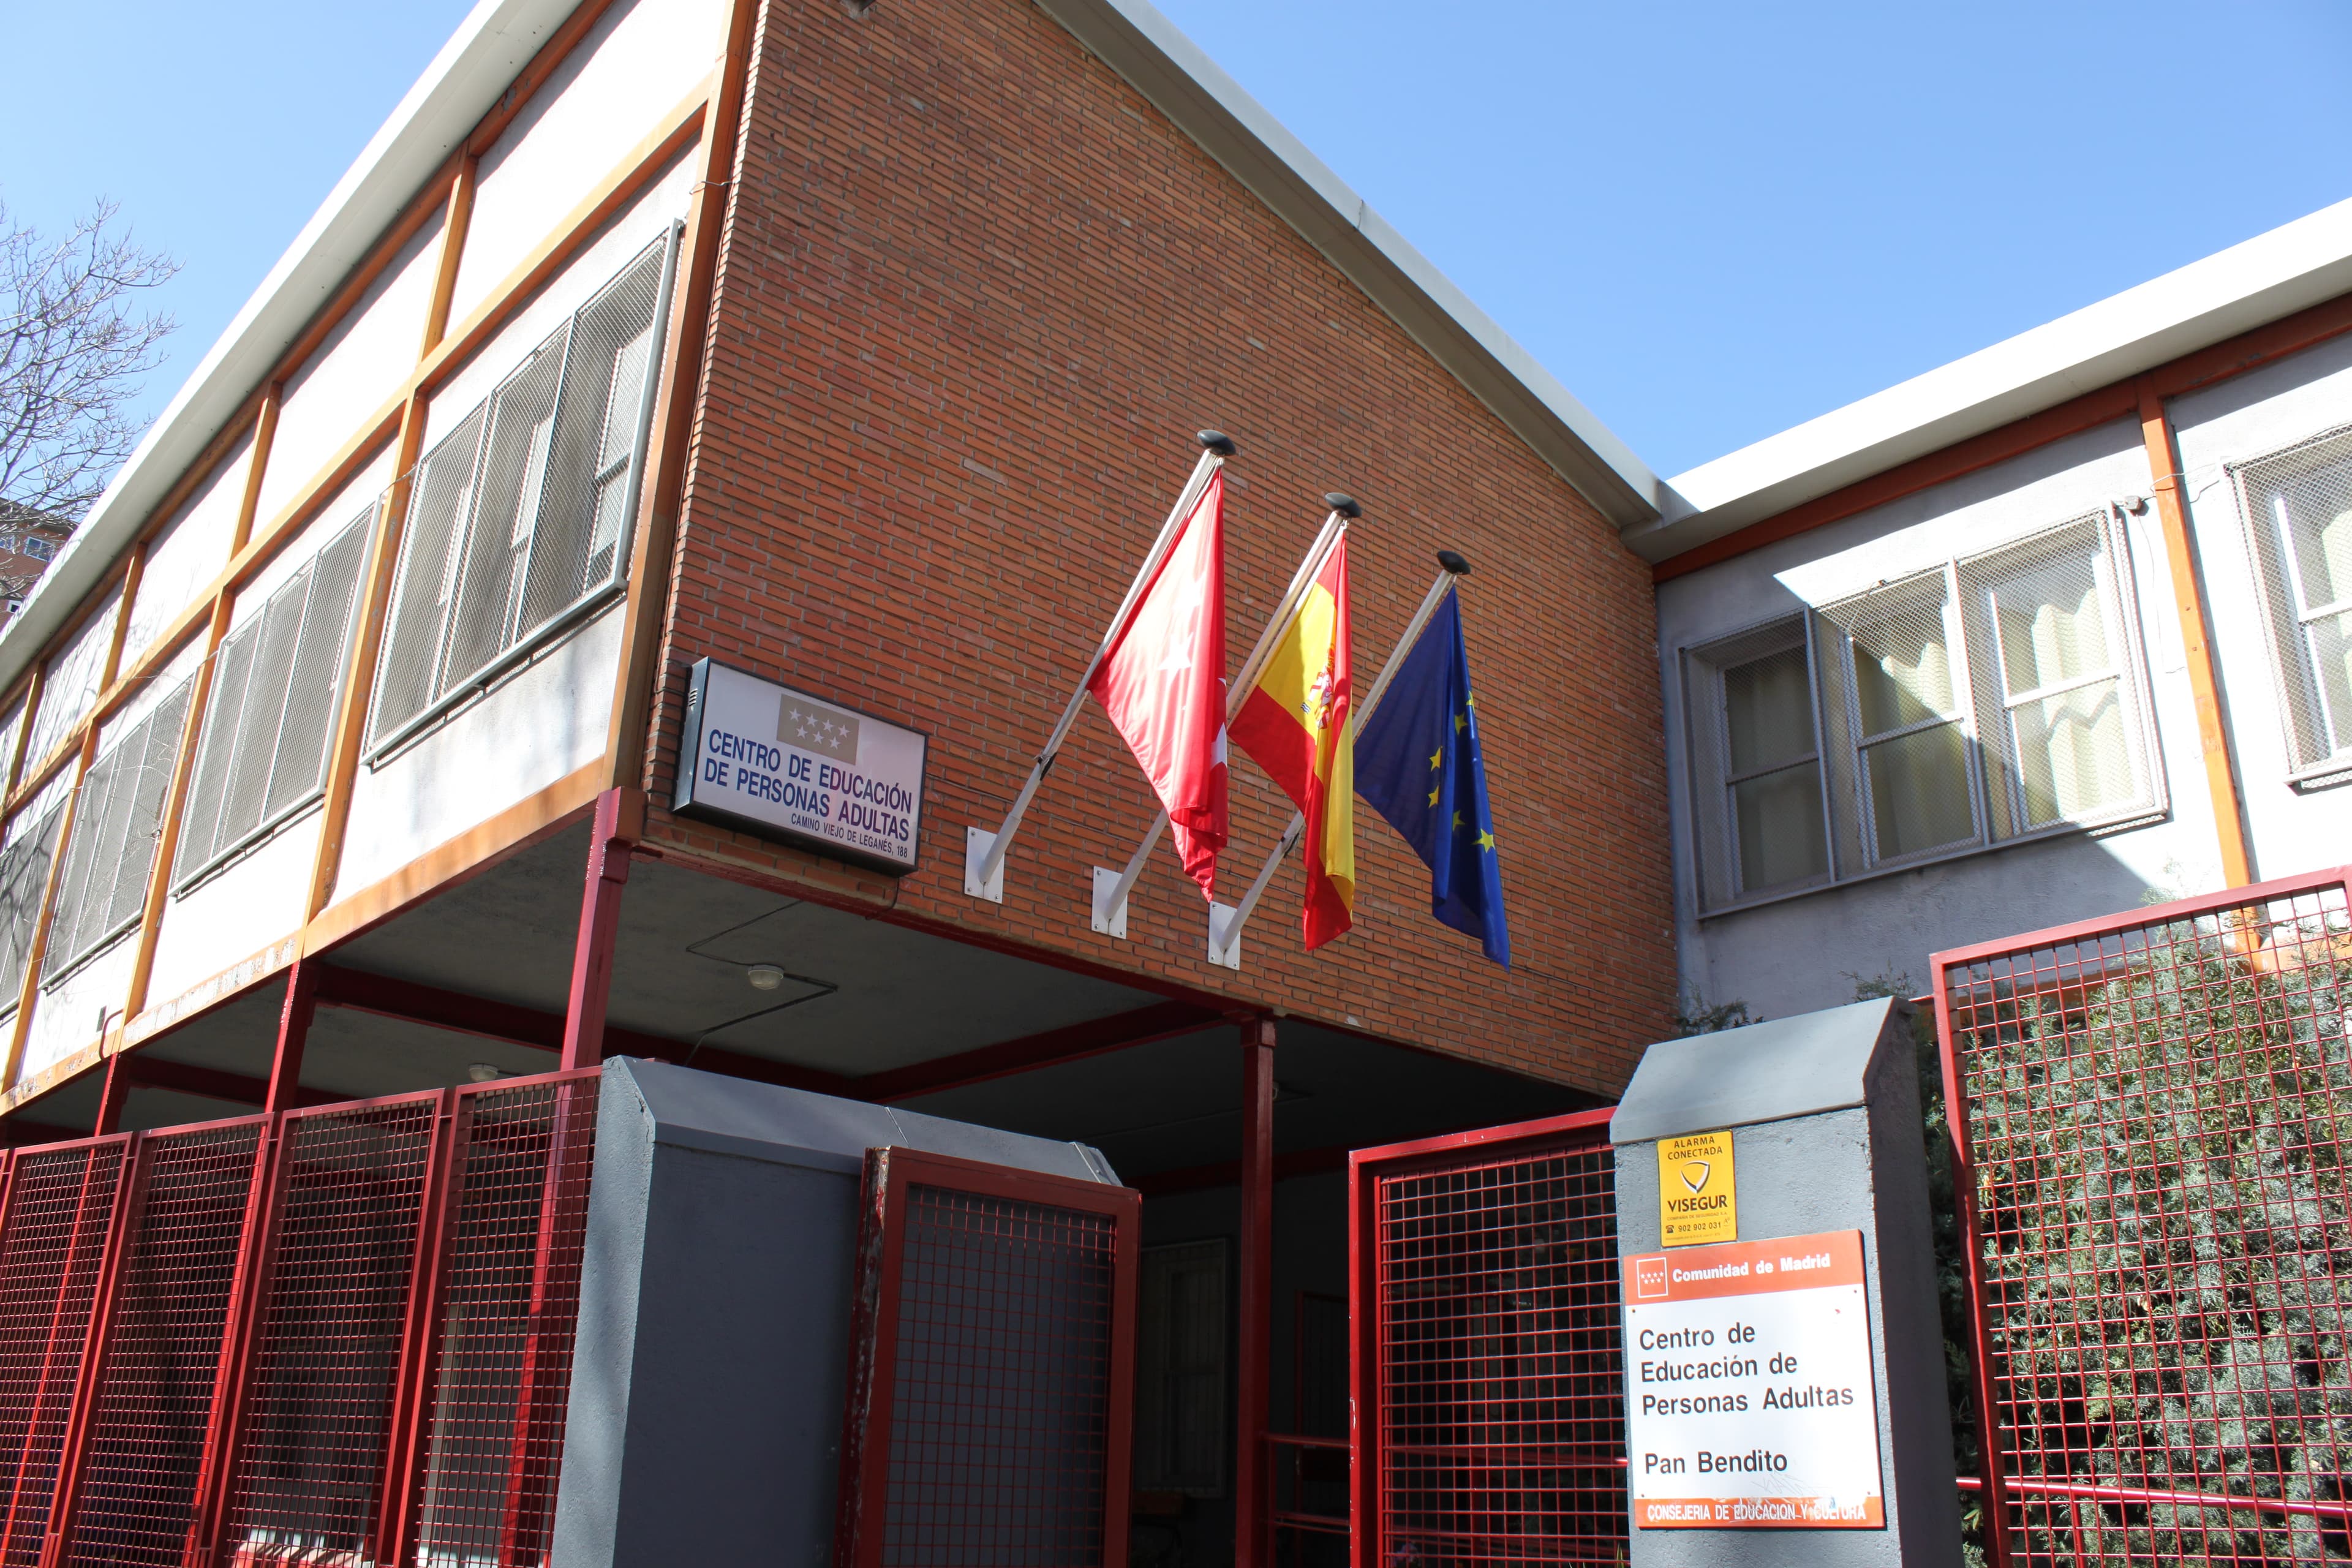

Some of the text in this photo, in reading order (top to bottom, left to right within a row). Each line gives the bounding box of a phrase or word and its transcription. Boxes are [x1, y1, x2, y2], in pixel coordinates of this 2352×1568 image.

[709, 729, 912, 814] CENTRO DE EDUCACIÓN
[704, 758, 910, 842] DE PERSONAS ADULTAS
[791, 813, 908, 858] CAMINO VIEJO DE LEGANÉS, 188
[1667, 1146, 1723, 1160] CONECTADA
[1673, 1136, 1715, 1148] ALARMA
[1667, 1194, 1728, 1212] VISEGUR
[1673, 1253, 1830, 1283] Comunidad de Madrid
[1639, 1322, 1755, 1351] Centro de
[1640, 1352, 1797, 1382] Educación de
[1642, 1385, 1854, 1415] Personas Adultas
[1645, 1450, 1788, 1474] Pan Bendito
[1647, 1504, 1711, 1520] CONSEJERIA
[1715, 1504, 1730, 1520] DE
[1734, 1504, 1796, 1520] EDUCACION
[1800, 1504, 1807, 1520] Y
